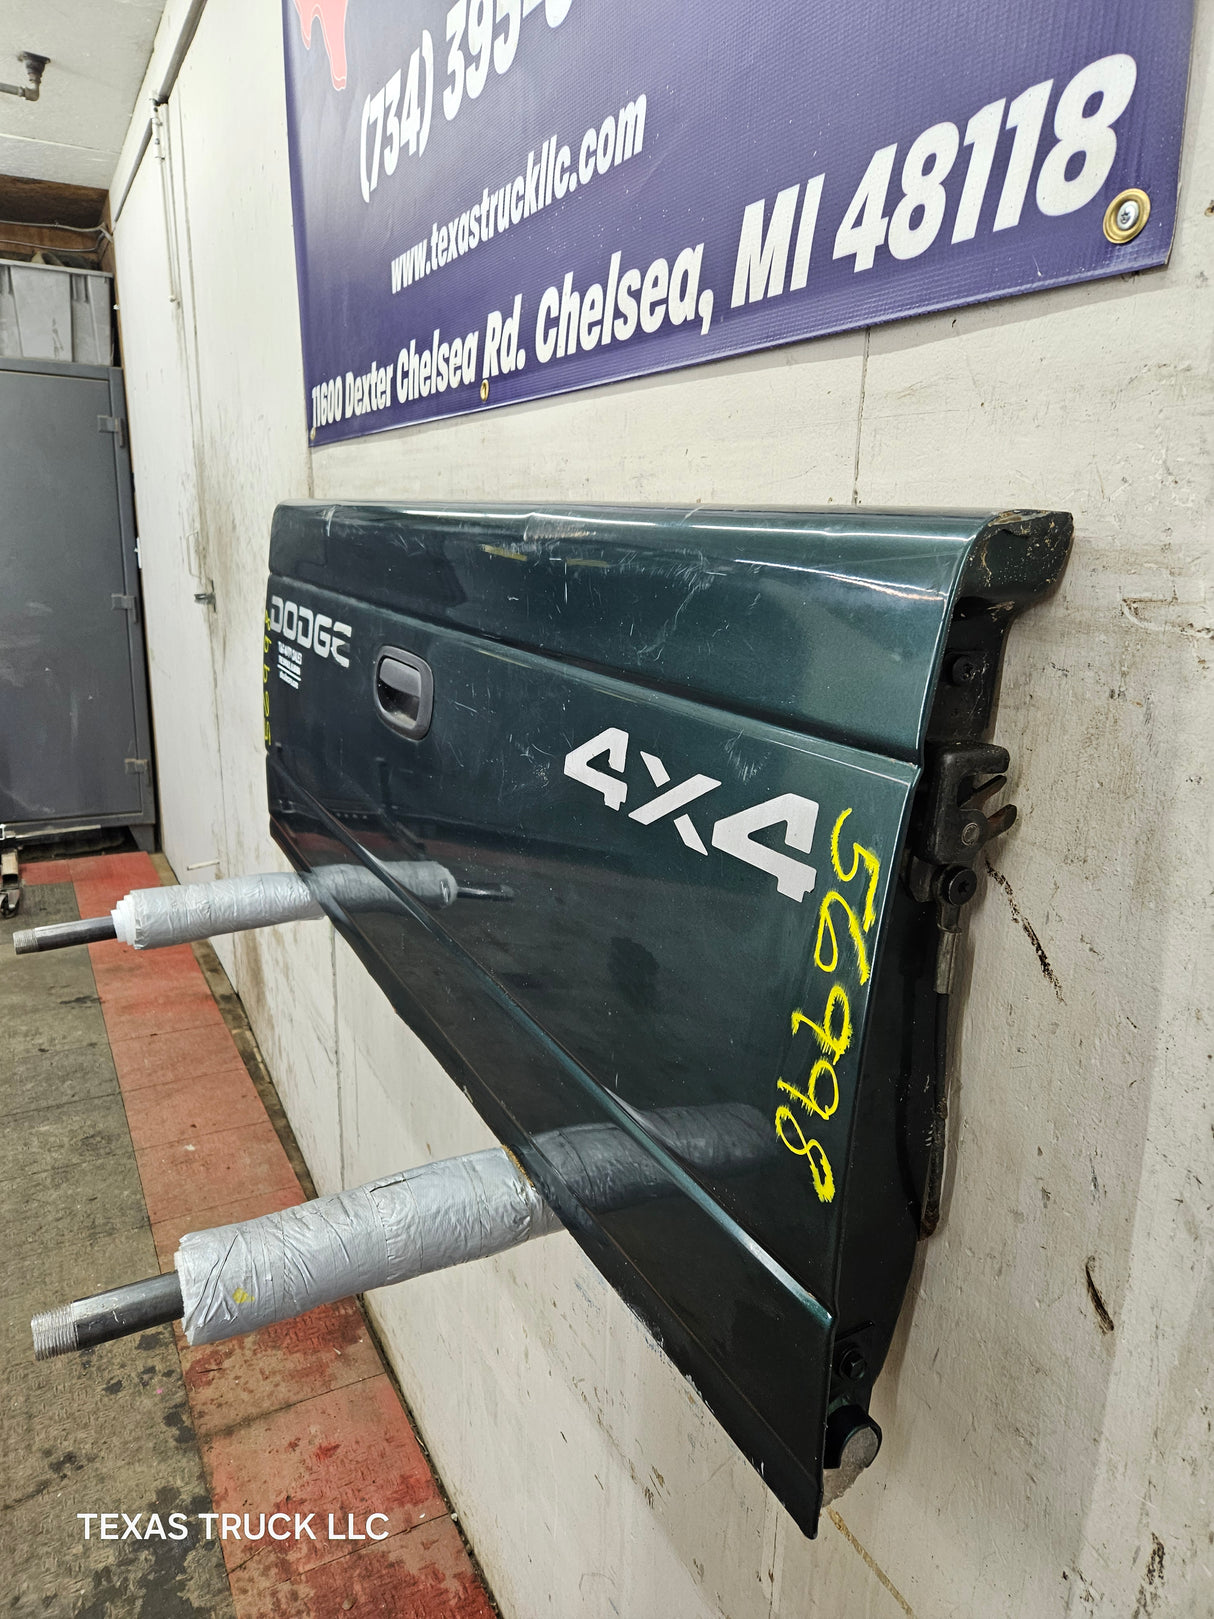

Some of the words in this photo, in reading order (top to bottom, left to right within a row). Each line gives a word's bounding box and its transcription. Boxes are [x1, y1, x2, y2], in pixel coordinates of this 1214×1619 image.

[360, 29, 434, 203] (734)
[391, 94, 647, 294] www.texastruckllc.com
[311, 375, 342, 428] 11600
[345, 361, 394, 418] Dexter
[396, 330, 479, 404] Chelsea
[482, 293, 526, 380] Rd.
[535, 243, 714, 363] Chelsea,
[730, 173, 826, 309] MI
[832, 53, 1137, 273] 48118
[270, 595, 352, 668] DODGE
[775, 808, 880, 1203] 56998
